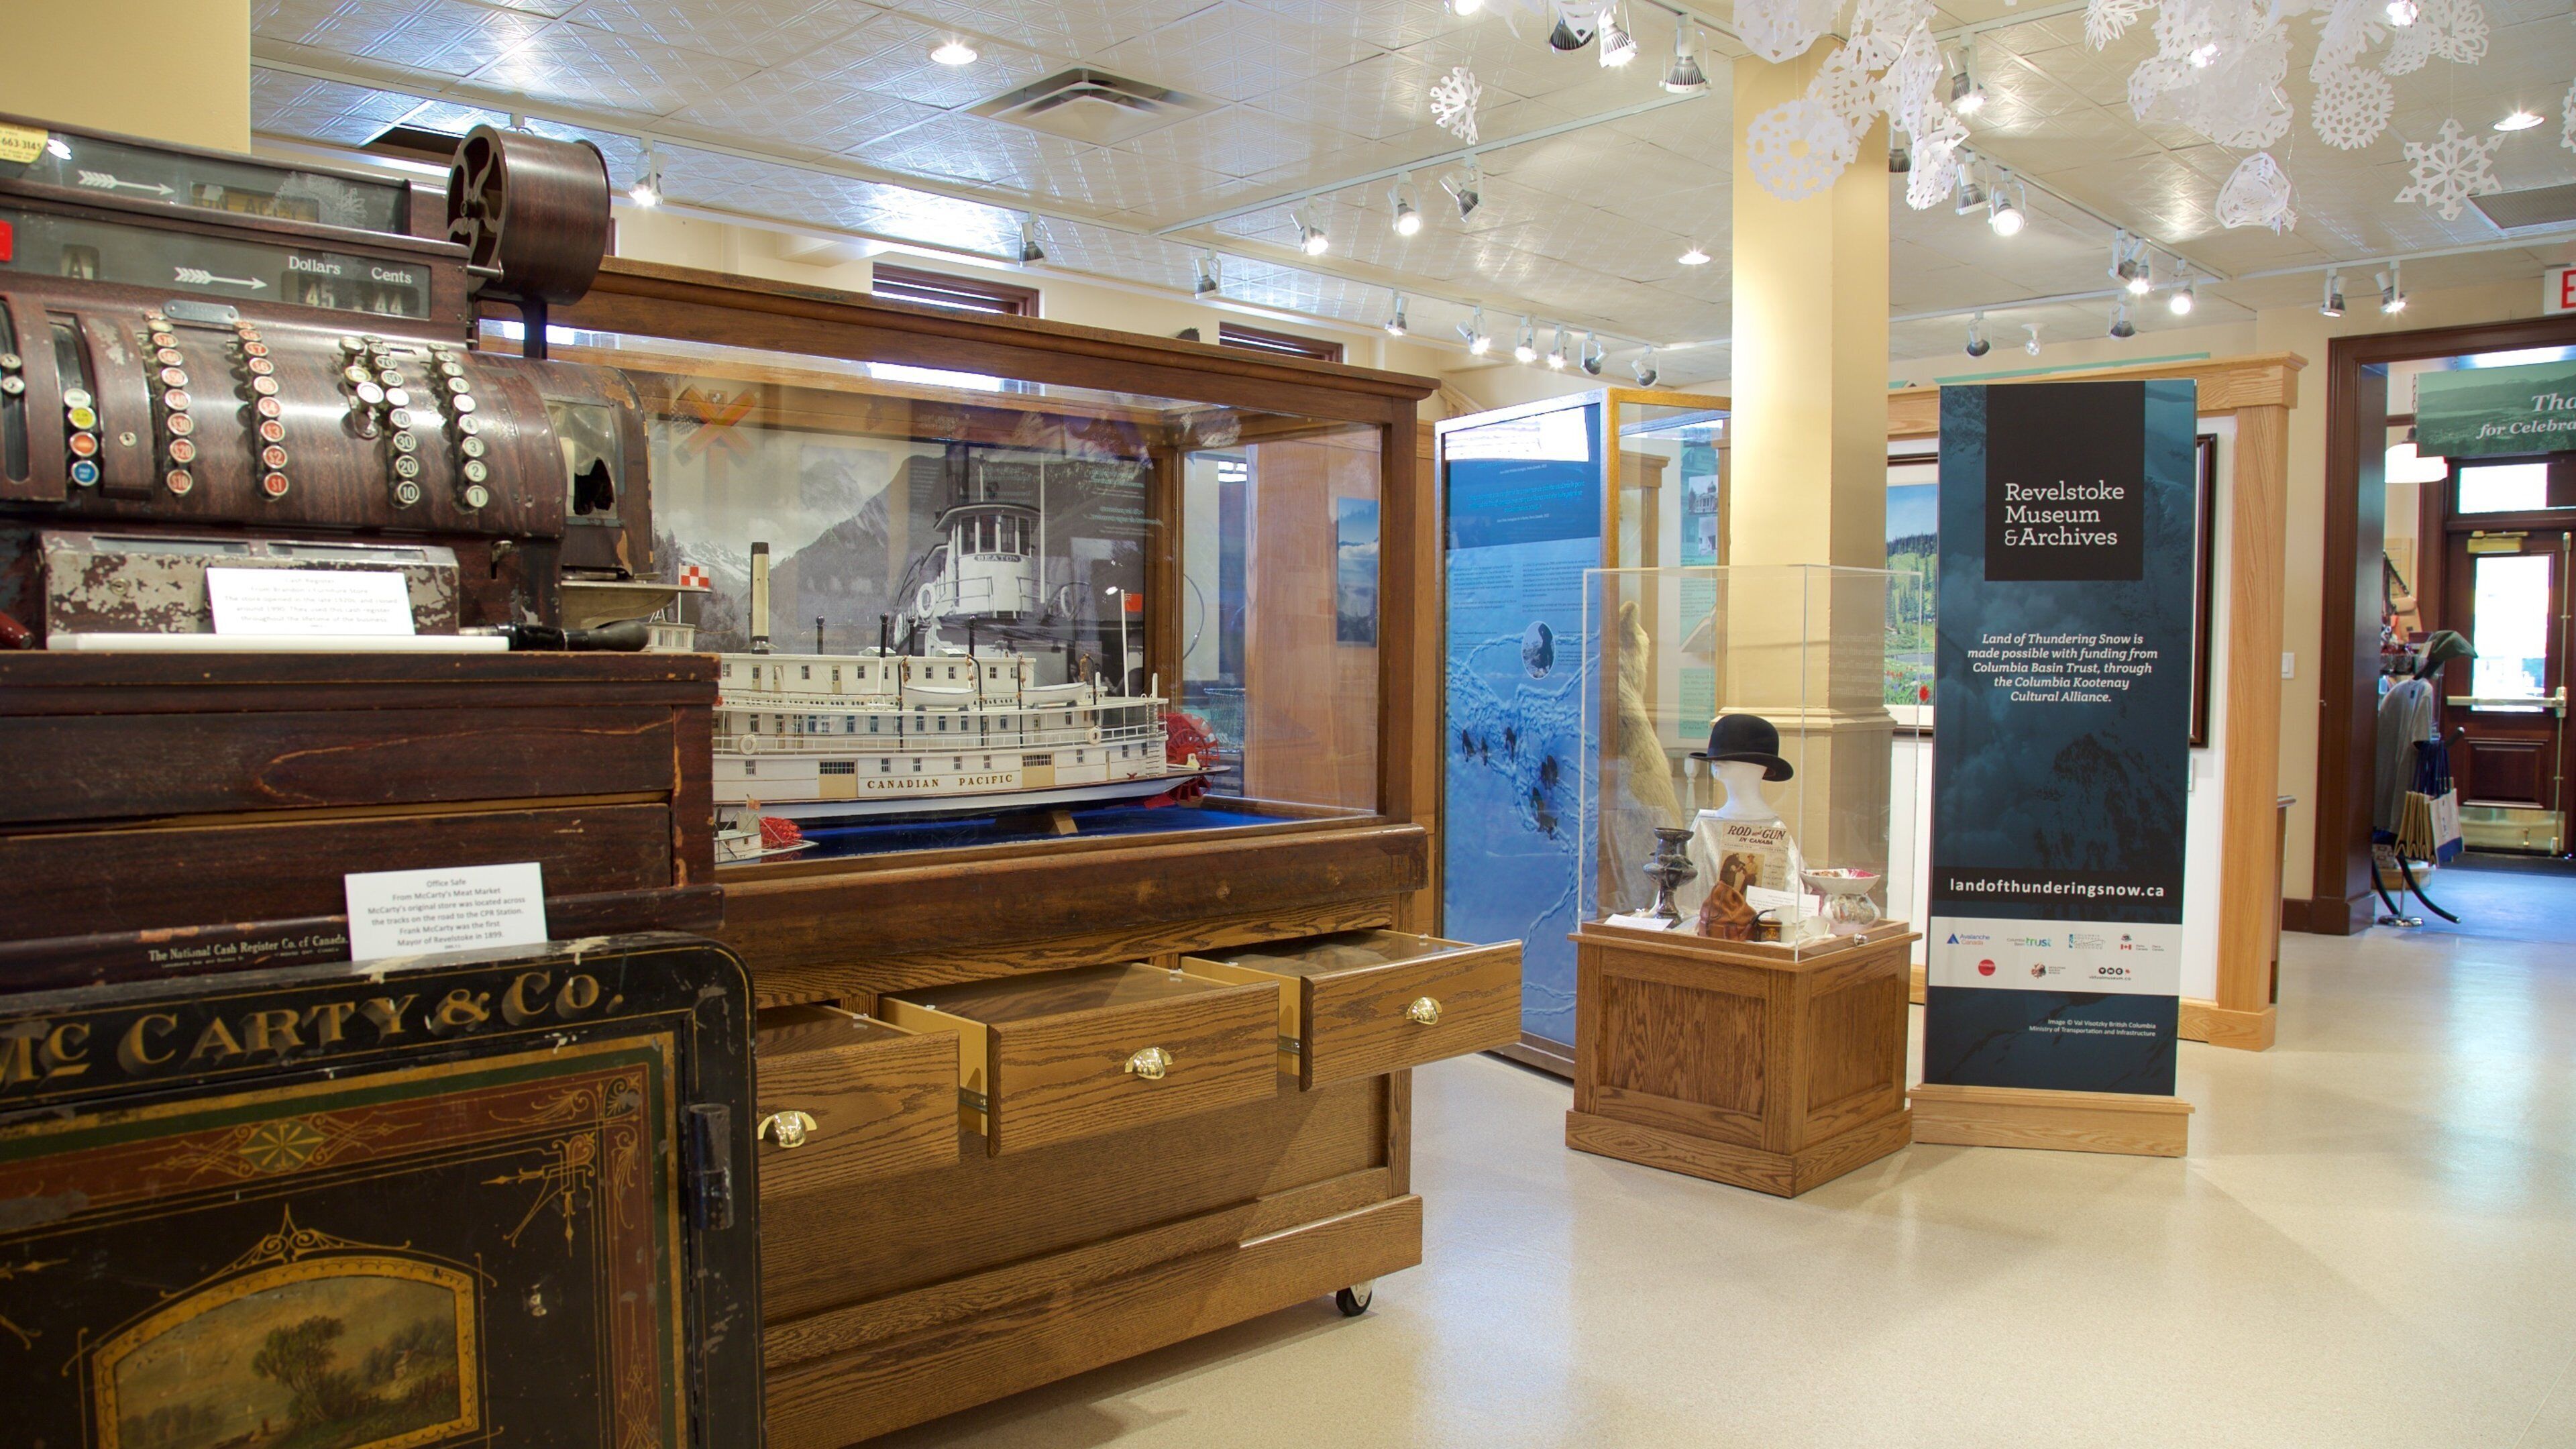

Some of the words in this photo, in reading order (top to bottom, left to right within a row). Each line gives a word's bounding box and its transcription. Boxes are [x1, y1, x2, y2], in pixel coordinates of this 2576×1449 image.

[288, 256, 341, 276] Dollars
[371, 267, 412, 284] Cents
[378, 357, 394, 367] 70
[384, 373, 400, 384] 60
[2531, 392, 2576, 413] Tha
[394, 413, 409, 424] 40
[2475, 424, 2506, 440] for
[2510, 419, 2576, 435] Celebra
[397, 435, 412, 448] 30
[470, 442, 477, 453] 3
[269, 451, 282, 464] $2
[400, 460, 413, 474] 20
[472, 466, 479, 477] 2
[172, 476, 189, 490] $10
[272, 478, 282, 492] $1
[402, 486, 415, 499] 10
[2005, 480, 2125, 501] Revelstoke
[2005, 505, 2100, 523] Museum
[1982, 633, 2012, 645] Land
[2014, 633, 2027, 646] of
[2029, 633, 2098, 647] Thundering
[2098, 634, 2131, 645] Snow
[2133, 633, 2144, 645] is
[1968, 648, 2000, 659] made
[2002, 648, 2049, 661] possible
[2051, 648, 2078, 659] with
[2079, 647, 2127, 661] funding
[2128, 647, 2158, 661] from
[1973, 662, 2029, 673] Columbia
[2031, 662, 2063, 674] Basin
[2066, 663, 2100, 675] Trust,
[2104, 663, 2152, 676] through
[1994, 676, 2012, 687] the
[2015, 677, 2071, 688] Columbia
[2073, 678, 2130, 690] Kootenay
[2010, 691, 2059, 702] Cultural
[2061, 691, 2112, 702] Alliance.
[867, 778, 939, 789] CANADIAN
[959, 773, 1013, 786] PACIFIC
[1727, 825, 1752, 837] ROD
[1762, 829, 1787, 841] GUN
[427, 879, 449, 888] Office
[451, 878, 466, 886] Safe
[1949, 878, 2165, 898] landofthunderingsnow.ca
[392, 893, 413, 902] From
[415, 890, 451, 900] McCarty's
[453, 889, 474, 898] Meat
[475, 886, 500, 896] Market
[368, 905, 407, 915] McCarty's
[408, 902, 436, 913] original
[437, 902, 456, 910] store
[474, 897, 501, 907] located
[372, 918, 384, 926] the
[386, 916, 409, 924] tracks
[423, 914, 435, 922] the
[437, 912, 455, 921] road
[456, 912, 464, 920] to
[466, 910, 479, 918] the
[480, 909, 494, 917] CPR
[496, 907, 524, 916] Station.
[399, 926, 421, 935] Frank
[423, 924, 454, 934] McCarty
[472, 921, 485, 929] the
[486, 920, 500, 928] first
[397, 938, 422, 948] Mayor
[424, 936, 433, 945] of
[433, 934, 474, 944] Revelstoke
[484, 930, 504, 939] 1899.
[2026, 937, 2051, 947] trust
[148, 950, 167, 962] The
[170, 945, 211, 961] National
[213, 944, 237, 956] Cash
[240, 941, 278, 954] Register
[282, 937, 297, 949] Co.
[299, 936, 308, 947] of
[312, 933, 349, 947] Canada.
[121, 993, 421, 1067] CARTY
[436, 988, 491, 1027] &
[504, 970, 625, 1027] Co.
[2084, 1020, 2108, 1028] Visotzky
[2129, 1022, 2156, 1030] Columbia
[2061, 1026, 2103, 1034] Transportation
